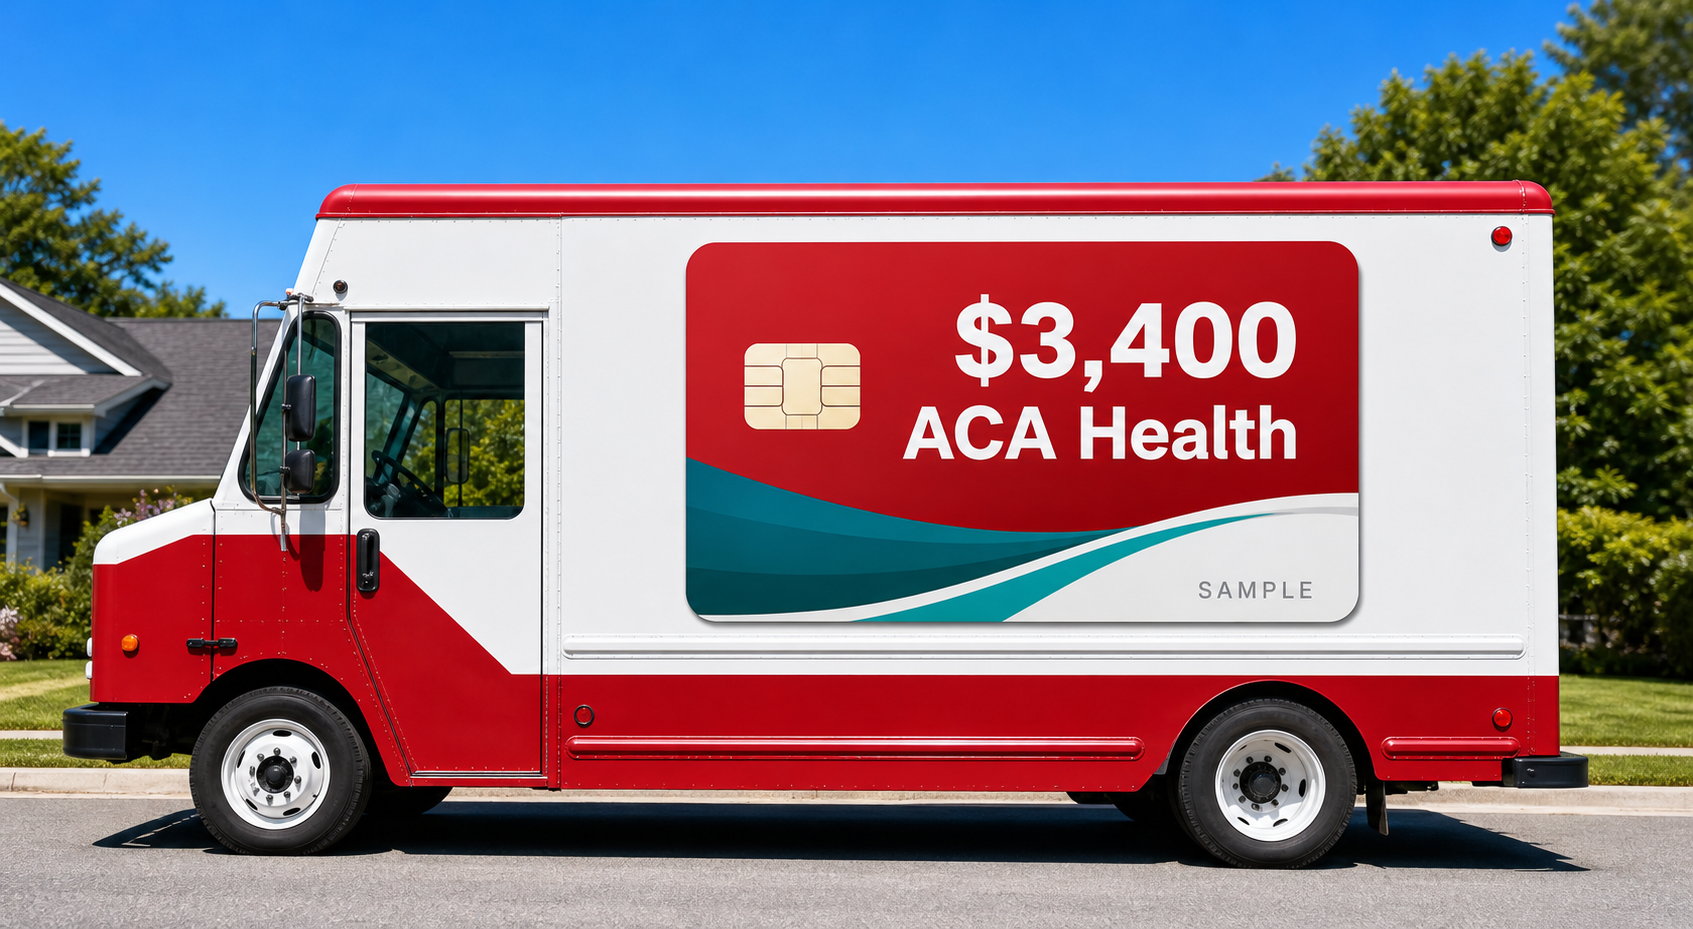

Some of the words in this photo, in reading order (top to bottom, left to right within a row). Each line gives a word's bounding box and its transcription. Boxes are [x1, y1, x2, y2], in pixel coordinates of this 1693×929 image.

[954, 294, 1297, 393] $3,400
[902, 405, 1057, 461] ACA
[1080, 405, 1297, 461] Health
[1198, 581, 1314, 600] SAMPLE
